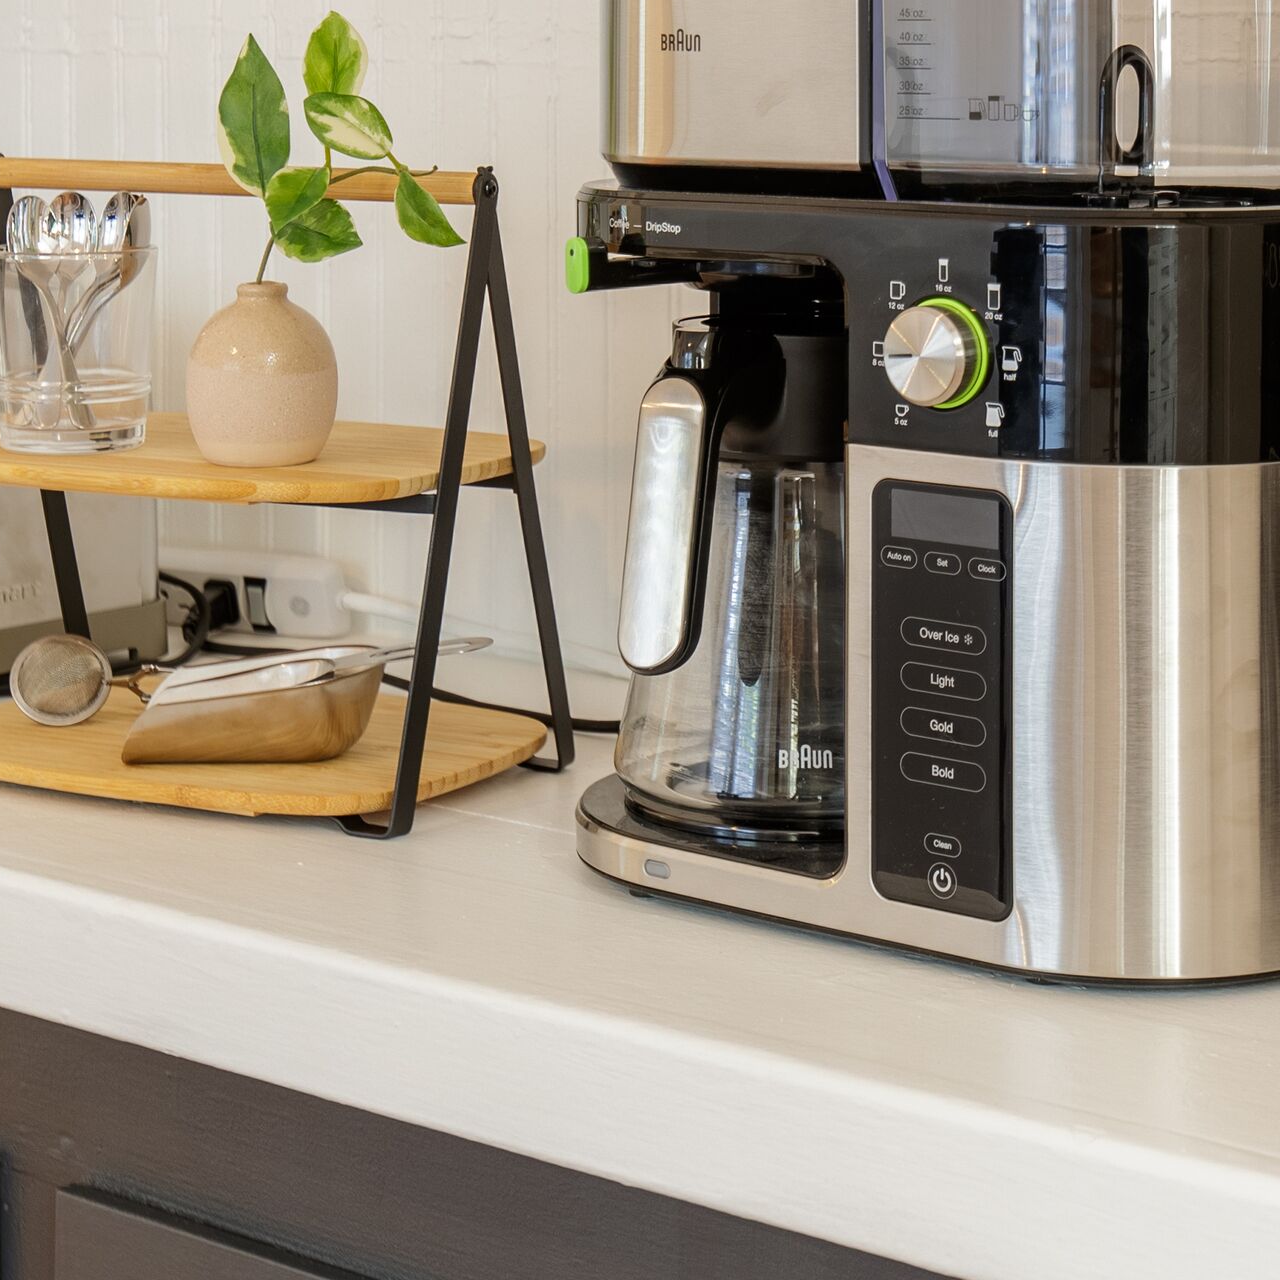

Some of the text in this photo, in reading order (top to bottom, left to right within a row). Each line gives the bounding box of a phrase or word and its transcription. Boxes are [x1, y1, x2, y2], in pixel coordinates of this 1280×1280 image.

[899, 8, 911, 18] 45
[660, 28, 701, 52] BRAUN
[899, 32, 911, 42] 40
[645, 221, 682, 236] DripStop
[943, 285, 952, 293] oz
[888, 301, 905, 311] 12 oz
[984, 312, 1003, 321] 20 oz
[1003, 373, 1017, 381] half
[988, 430, 999, 438] full
[886, 551, 912, 562] Auto on
[936, 558, 949, 568] Set
[977, 563, 997, 574] Clock
[919, 627, 960, 644] Over Ice
[930, 673, 955, 688] Light
[929, 719, 954, 734] Gold
[778, 744, 833, 769] BRAUN
[931, 764, 955, 780] Bold
[933, 838, 953, 851] Clean
